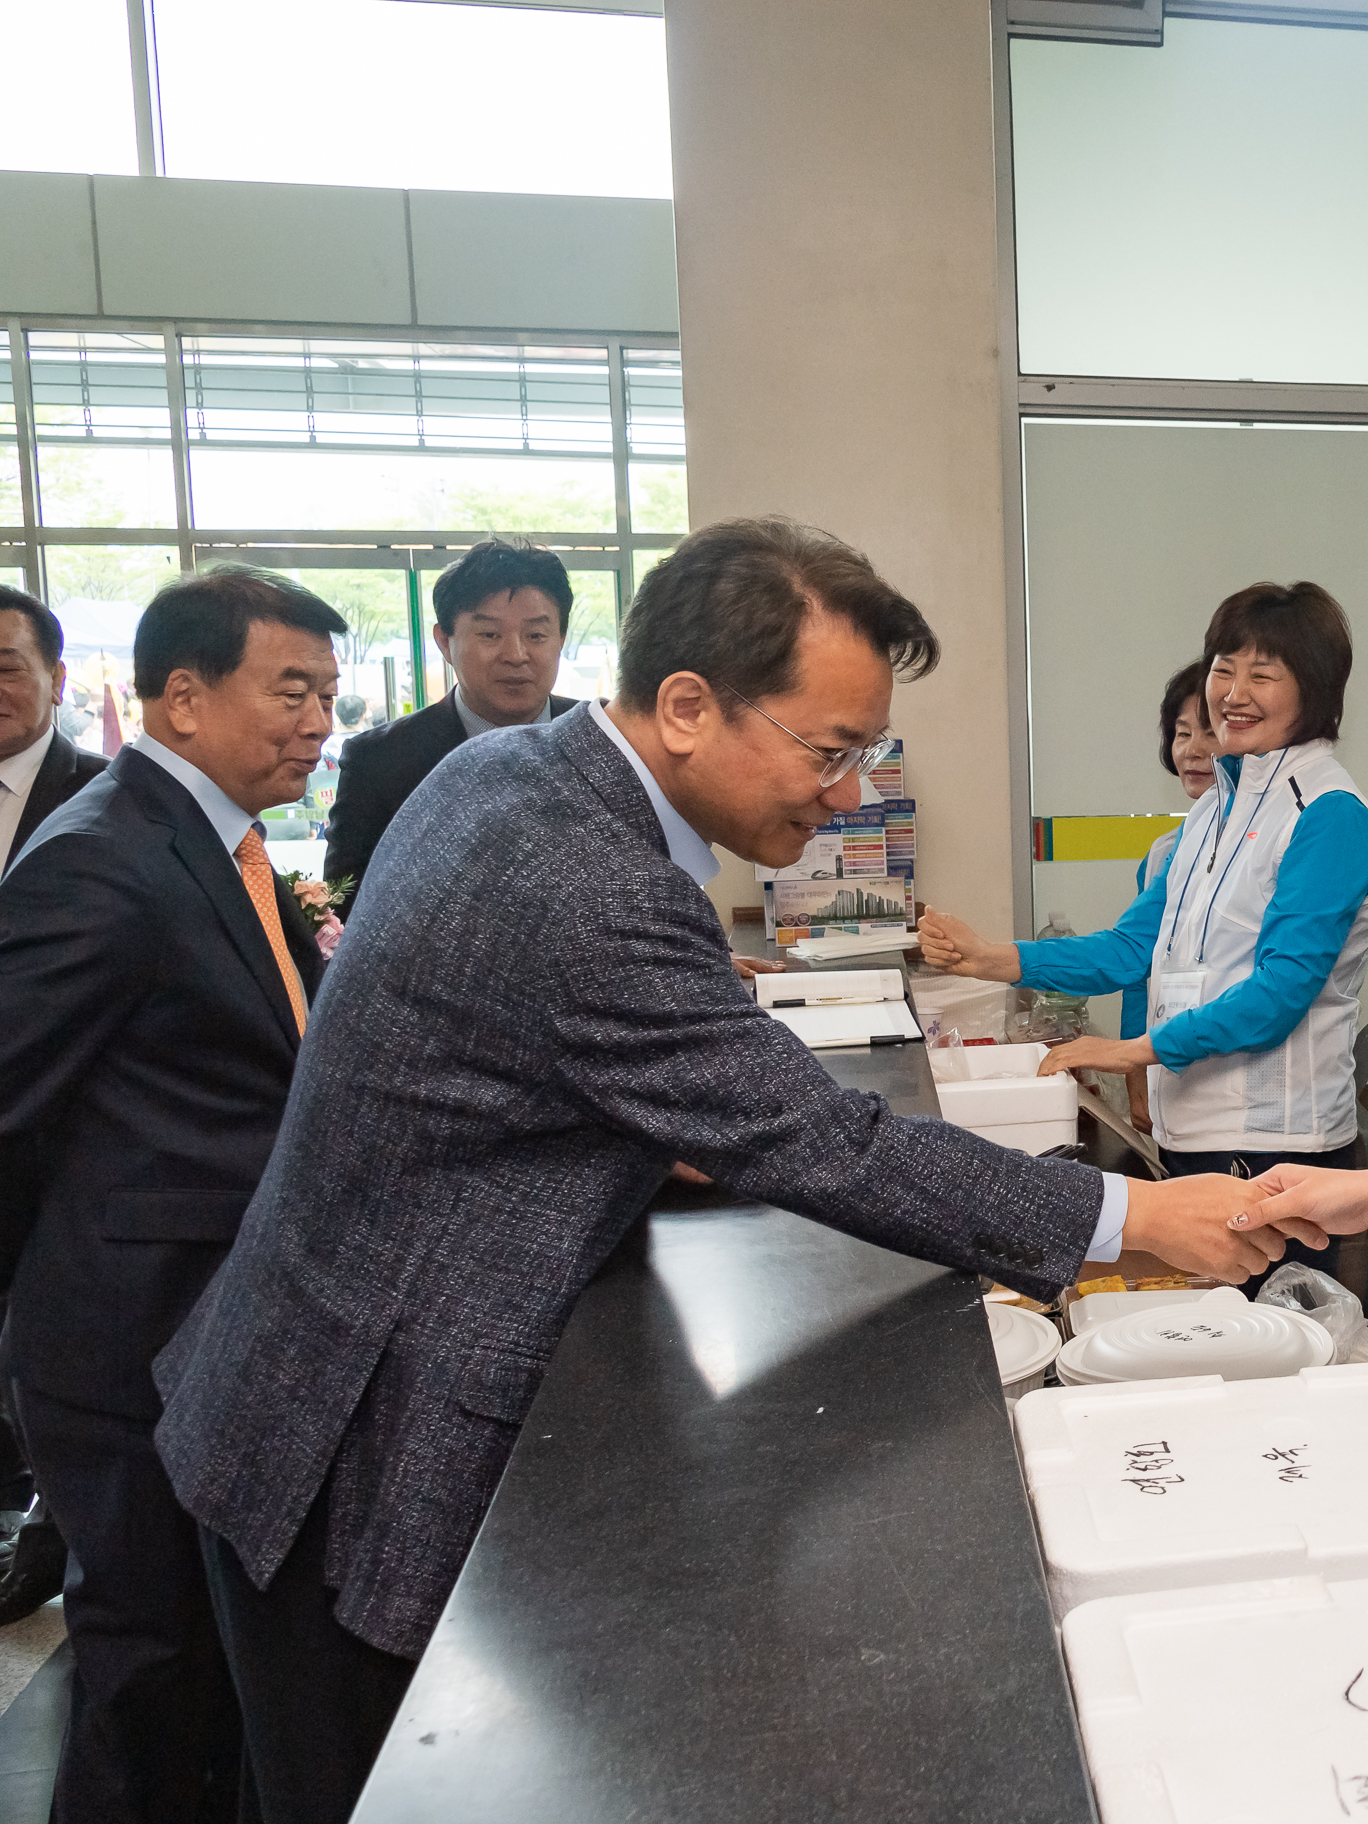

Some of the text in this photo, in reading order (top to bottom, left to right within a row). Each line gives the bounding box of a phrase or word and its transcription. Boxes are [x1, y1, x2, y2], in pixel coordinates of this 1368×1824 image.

[833, 814, 882, 825] 가질 마지막 기회!
